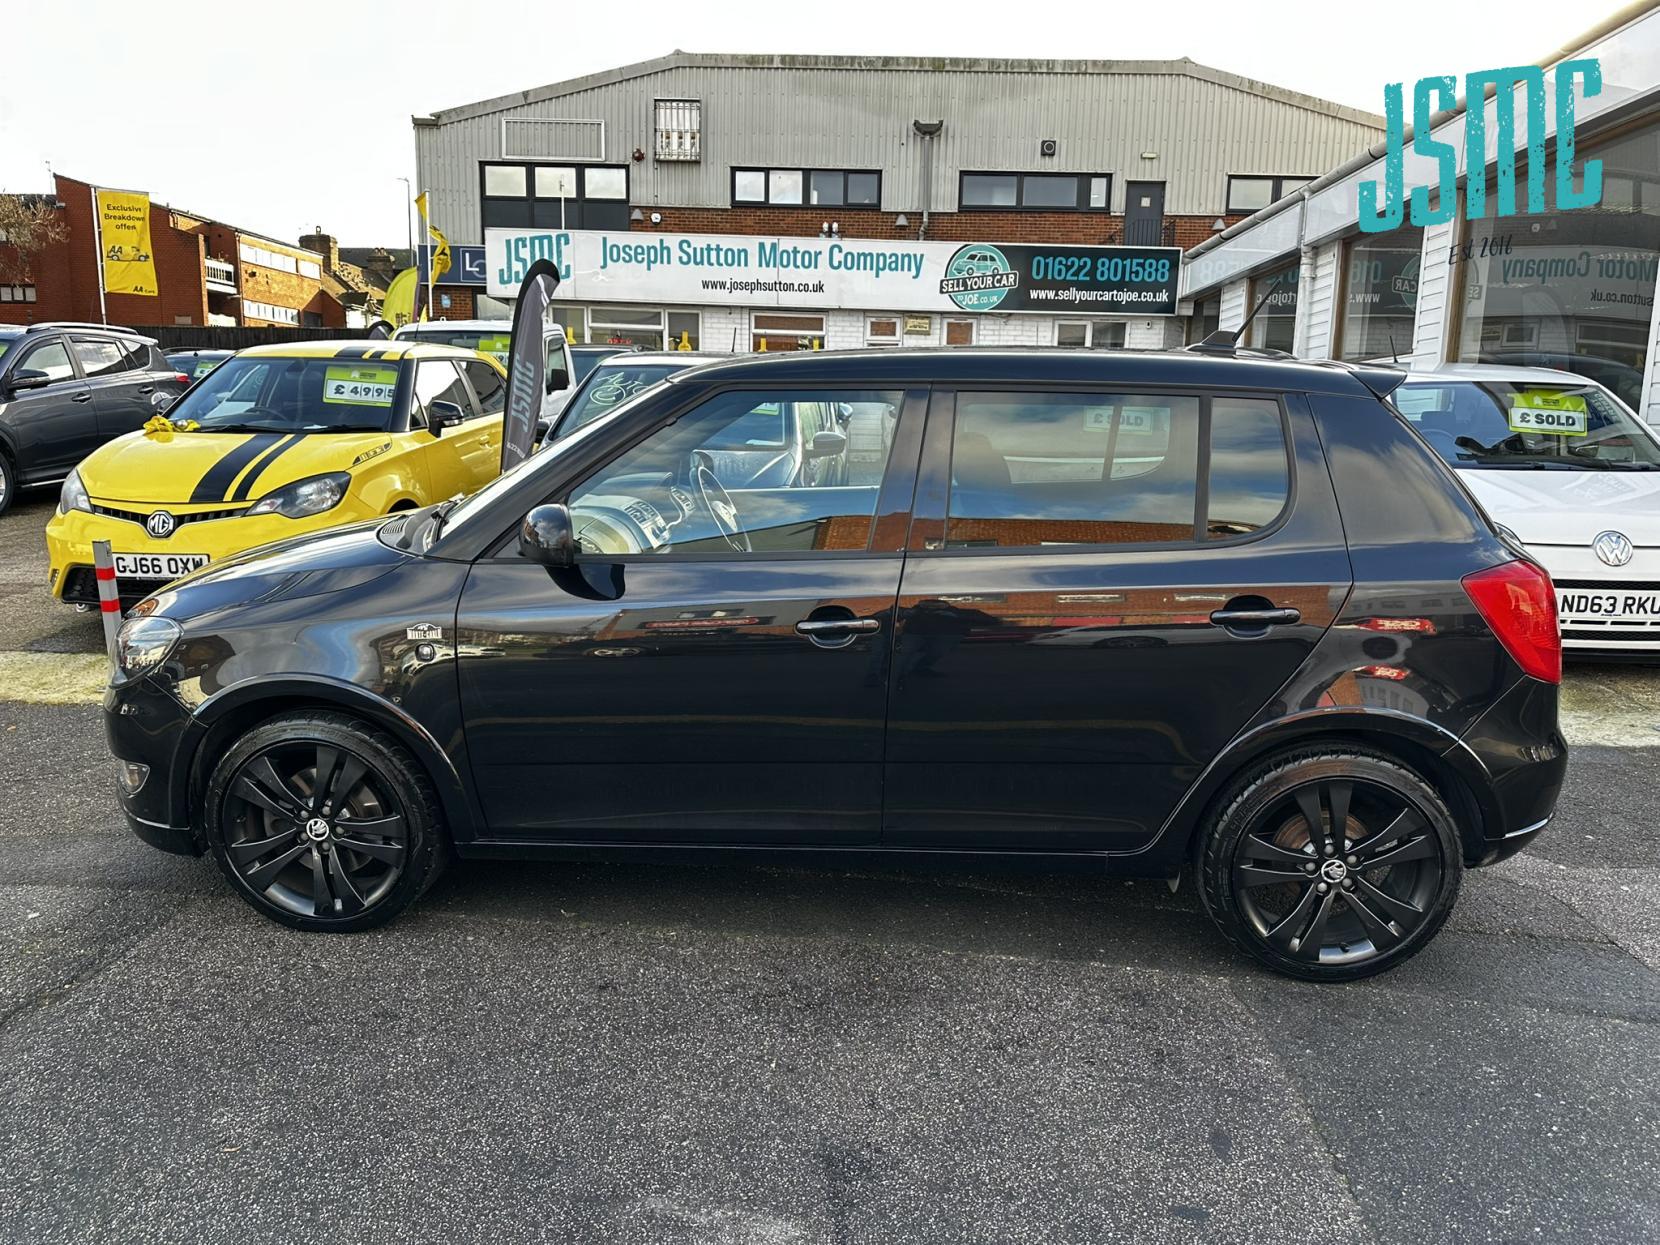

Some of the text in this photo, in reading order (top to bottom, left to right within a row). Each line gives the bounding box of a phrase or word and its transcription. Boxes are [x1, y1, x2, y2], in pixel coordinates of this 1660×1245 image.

[106, 203, 142, 212] Exclusiv
[498, 233, 572, 285] JSMC
[600, 236, 925, 279] Joseph Sutton Motor Company
[1031, 256, 1170, 283] 01622 801588
[701, 278, 825, 294] www.josephsutton.co.uk
[942, 274, 1015, 292] SELL YOUR CAR
[1029, 287, 1169, 304] www.sellyourcartojoe.co.uk
[1534, 414, 1576, 426] SOLD
[149, 514, 170, 534] MG
[1597, 532, 1631, 565] VW
[115, 556, 204, 575] GJ66 OXW
[1560, 594, 1660, 615] ND63 RKU
